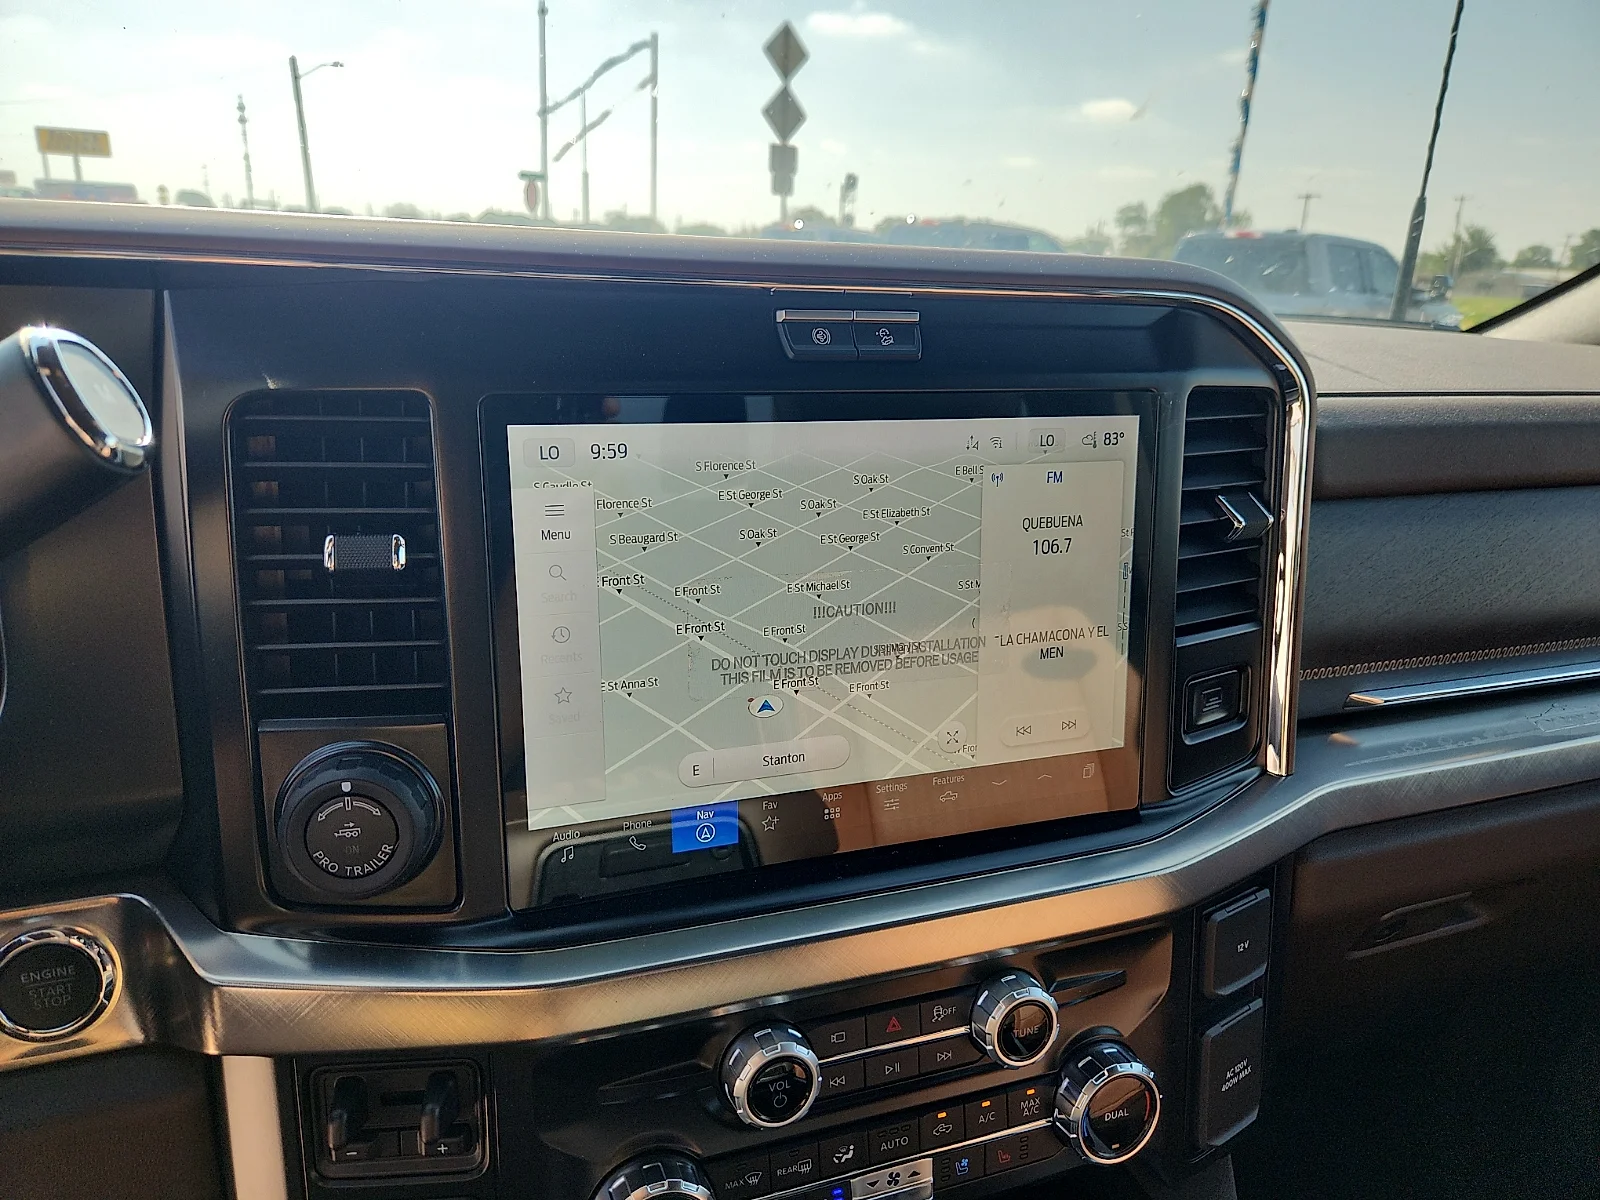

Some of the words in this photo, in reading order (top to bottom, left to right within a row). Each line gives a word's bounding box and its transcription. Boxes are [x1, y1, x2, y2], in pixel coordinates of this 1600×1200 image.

[1040, 434, 1055, 447] LO
[540, 445, 560, 460] LO
[590, 443, 628, 460] 9:59
[695, 461, 702, 472] S
[704, 460, 743, 472] Florence
[745, 459, 757, 471] St
[955, 466, 961, 476] E
[962, 465, 978, 475] Bell
[854, 475, 860, 485] S
[860, 474, 878, 485] Oak
[879, 473, 889, 484] St
[1047, 470, 1063, 484] FM
[718, 490, 725, 501] E
[725, 490, 737, 501] St
[738, 489, 770, 503] George
[771, 488, 783, 499] St
[597, 498, 639, 510] Florence
[641, 497, 653, 509] St
[801, 500, 807, 510] S
[807, 499, 827, 510] Oak
[827, 499, 837, 509] St
[863, 509, 869, 519] E
[869, 508, 880, 518] St
[881, 506, 919, 518] Elizabeth
[920, 506, 931, 517] St
[1022, 514, 1084, 533] QUEBUENA
[541, 529, 571, 541] Menu
[610, 534, 617, 545] S
[618, 531, 666, 547] Beaugard
[667, 531, 679, 542] St
[739, 529, 746, 540] S
[746, 528, 765, 540] Oak
[766, 528, 778, 539] St
[820, 534, 826, 544] E
[827, 534, 838, 544] St
[839, 533, 869, 546] George
[870, 532, 880, 542] St
[903, 545, 909, 555] S
[909, 543, 944, 555] Convent
[945, 542, 955, 553] St
[1033, 537, 1072, 555] 106.7
[601, 575, 631, 587] Front
[633, 573, 645, 585] St
[787, 583, 793, 593] E
[794, 582, 804, 593] St
[806, 580, 839, 592] Michael
[840, 579, 850, 591] St
[958, 580, 964, 590] S
[674, 586, 681, 596] E
[682, 585, 708, 597] Front
[709, 584, 721, 595] St
[813, 601, 896, 620] !!!CAUTION!!!
[676, 624, 683, 635] E
[684, 622, 712, 635] Front
[714, 621, 726, 632] St
[763, 627, 770, 637] E
[771, 625, 795, 636] Front
[797, 624, 806, 634] St
[1016, 627, 1086, 645] CHAMACONA
[1088, 626, 1096, 638] Y
[1097, 625, 1110, 638] EL
[711, 657, 731, 672] DO
[733, 654, 760, 670] NOT
[762, 650, 806, 667] TOUCH
[809, 646, 860, 662] DISPLAY
[909, 635, 986, 655] INSTALLATION
[1040, 645, 1064, 660] MEN
[720, 671, 750, 686] THIS
[752, 668, 781, 683] FILM
[784, 667, 796, 680] IS
[798, 666, 815, 678] TO
[817, 663, 833, 677] BE
[835, 659, 893, 676] REMOVED
[895, 654, 940, 671] BEFORE
[942, 651, 979, 666] USAGE
[607, 681, 619, 692] St
[620, 680, 646, 690] Anna
[647, 677, 659, 688] St
[773, 680, 780, 690] E
[781, 678, 806, 689] Front
[809, 676, 819, 686] St
[849, 683, 855, 693] E
[856, 681, 878, 692] Front
[880, 680, 889, 690] St
[762, 752, 806, 768] Stanton
[692, 765, 700, 776] E
[932, 773, 965, 786] Features
[876, 781, 908, 794] Settings
[822, 791, 843, 803] Apps
[762, 801, 778, 811] Fav
[697, 809, 715, 821] Nav
[623, 818, 652, 832] Phone
[552, 829, 581, 843] Audio
[312, 850, 339, 873] PRO
[345, 843, 394, 877] TRAILER
[20, 964, 76, 984] ENGINE
[28, 982, 73, 999] START
[33, 994, 71, 1011] STOP
[943, 1005, 957, 1017] OFF
[1013, 1025, 1039, 1039] TUNE
[768, 1080, 791, 1092] VOL
[1020, 1096, 1041, 1110] MAX
[978, 1111, 996, 1125] A/C
[1022, 1104, 1040, 1118] A/C
[1104, 1107, 1130, 1122] DUAL
[880, 1136, 909, 1152] AUTO
[777, 1164, 798, 1177] REAR
[724, 1178, 745, 1191] MAX
